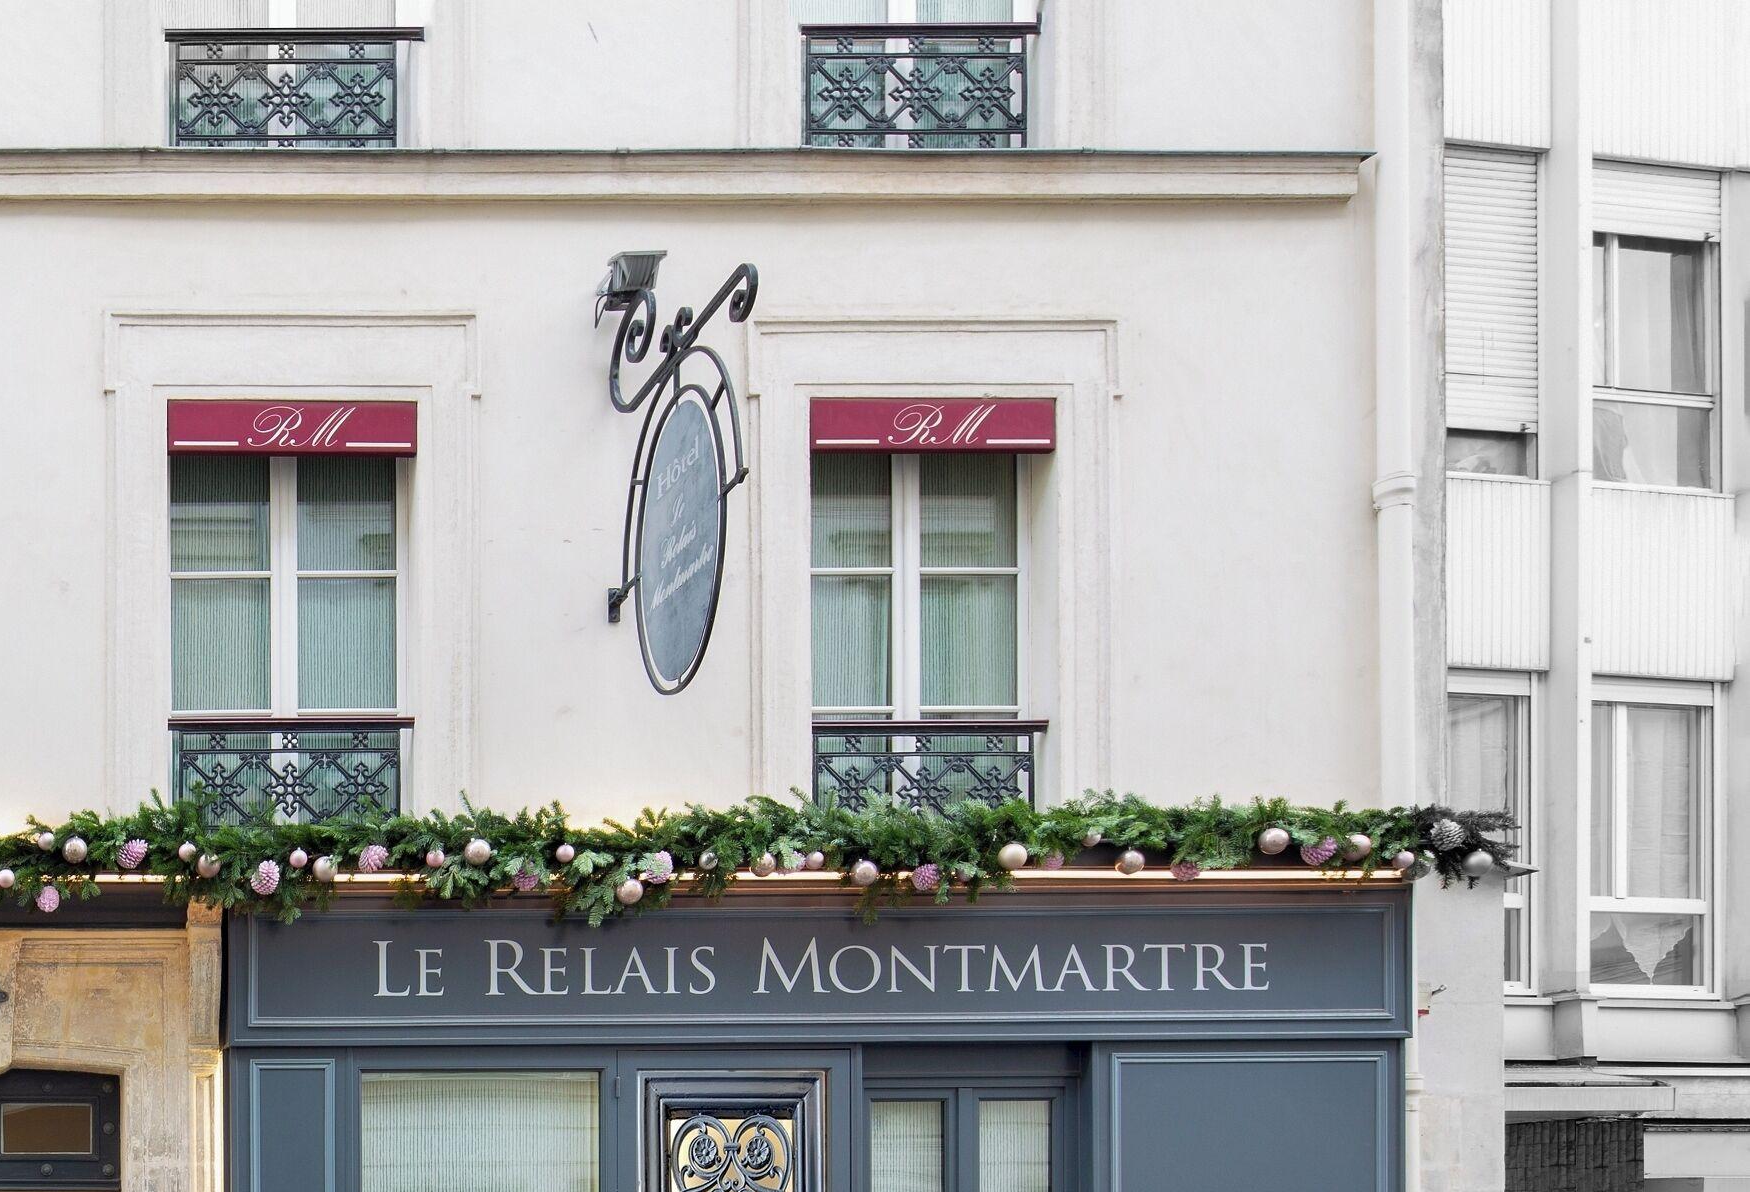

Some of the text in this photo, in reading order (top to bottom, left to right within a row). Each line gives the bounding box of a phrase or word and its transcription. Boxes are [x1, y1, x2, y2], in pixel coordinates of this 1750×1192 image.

[247, 405, 357, 449] RM
[887, 402, 997, 448] RM
[656, 434, 700, 500] Hôtel
[372, 936, 1271, 998] LE RELAIS MONTMARTRE
